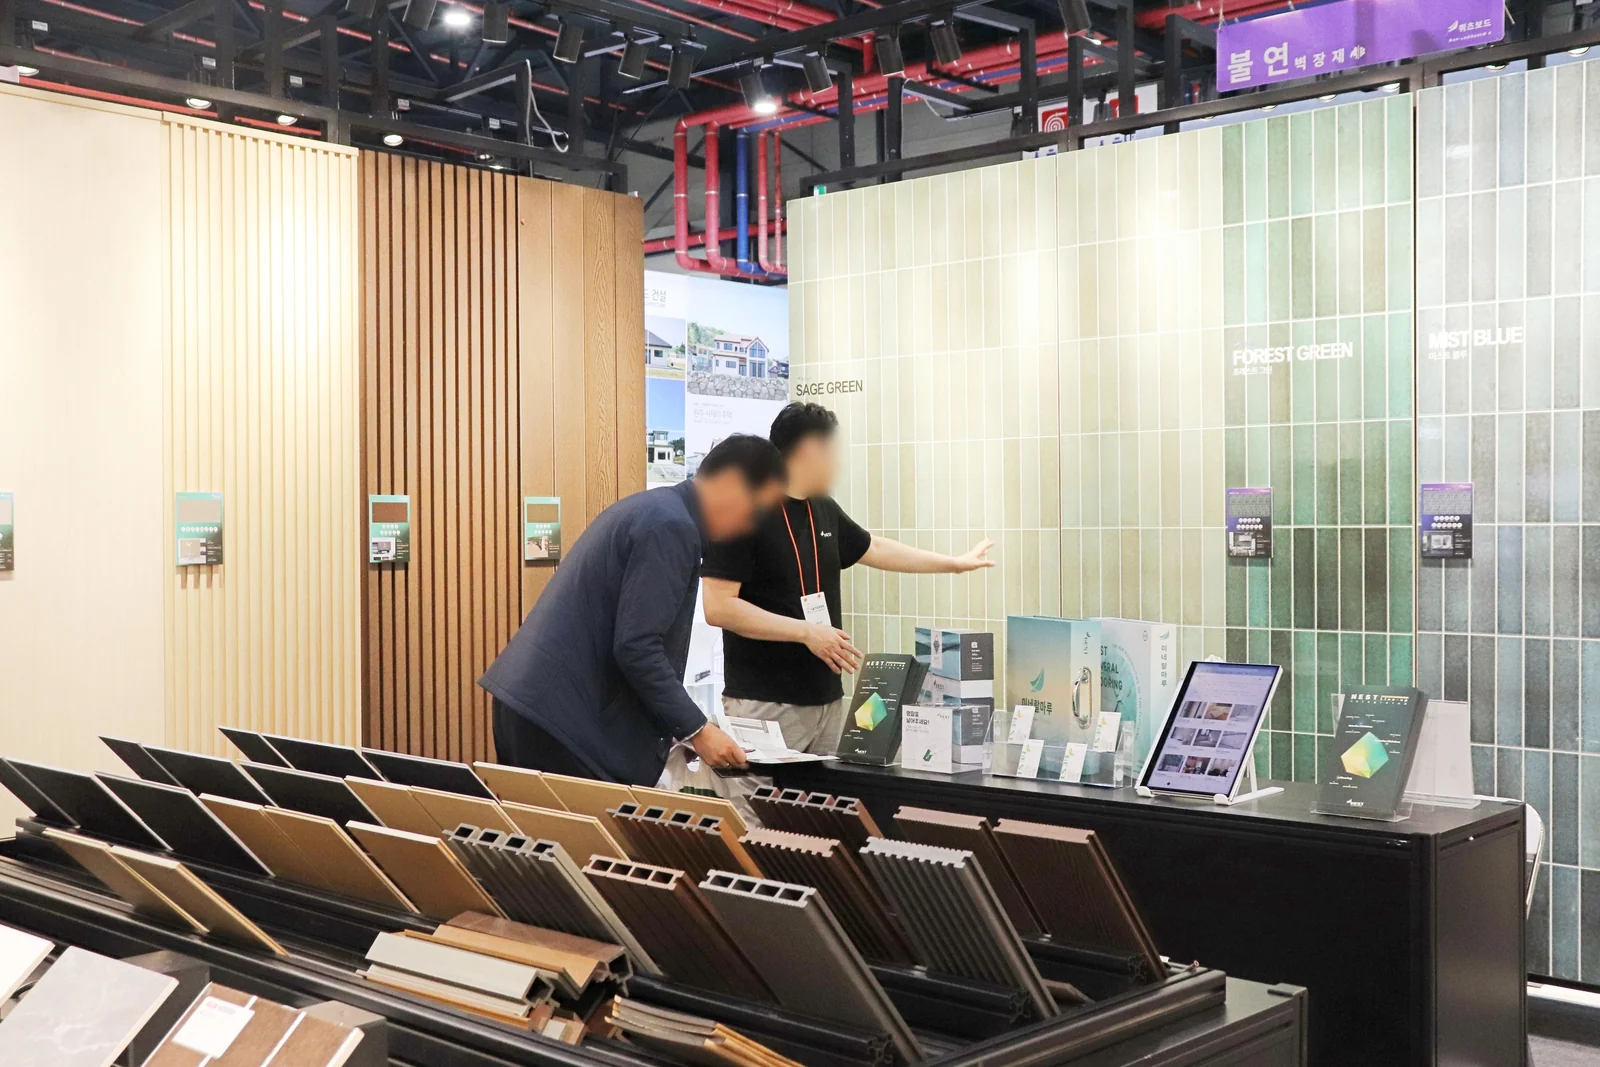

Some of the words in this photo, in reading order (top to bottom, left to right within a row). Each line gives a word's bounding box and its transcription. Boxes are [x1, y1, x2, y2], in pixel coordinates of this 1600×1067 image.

[1428, 330, 1470, 349] MIST
[1473, 326, 1524, 346] BLUE
[1232, 346, 1294, 366] FOREST
[1296, 341, 1354, 361] GREEN
[796, 382, 825, 397] SAGE
[826, 380, 864, 394] GREEN
